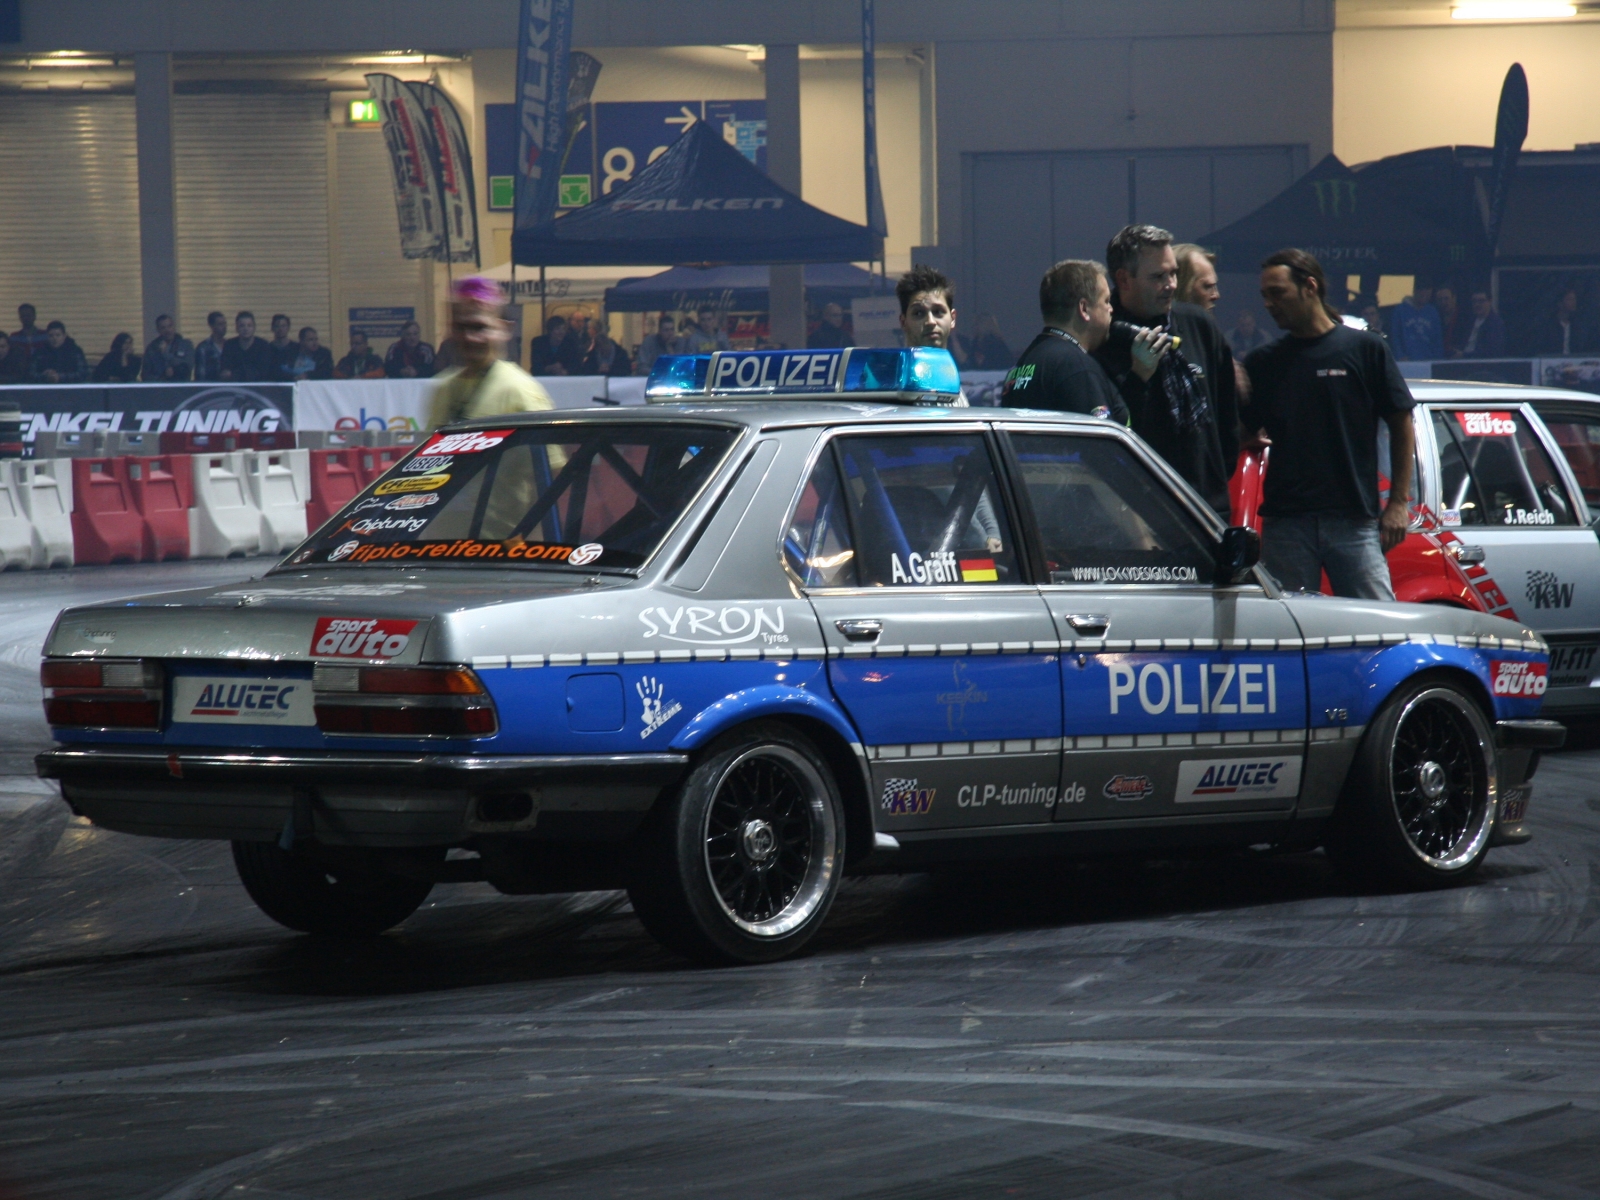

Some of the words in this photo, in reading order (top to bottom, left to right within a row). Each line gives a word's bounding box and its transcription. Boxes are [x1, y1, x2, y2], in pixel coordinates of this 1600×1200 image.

[611, 197, 784, 212] FALKEN
[715, 353, 839, 387] POLIZEI
[135, 409, 281, 433] TUNING
[1466, 417, 1517, 434] auto
[422, 437, 504, 455] auto
[351, 516, 427, 534] Chiptuning
[1504, 508, 1555, 526] J.Reich
[891, 552, 959, 585] A.Gräff
[1532, 583, 1574, 610] KW
[329, 619, 377, 634] sport
[638, 606, 785, 643] SYRON
[315, 631, 411, 657] auto
[761, 632, 789, 644] Tyres
[1498, 662, 1528, 675] sport
[194, 683, 296, 710] ALUTEC
[1108, 662, 1277, 715] POLIZEI
[1494, 672, 1548, 696] auto
[1196, 762, 1284, 788] ALUTEC
[889, 788, 936, 815] KW
[957, 781, 1087, 808] CLP-tuning.de
